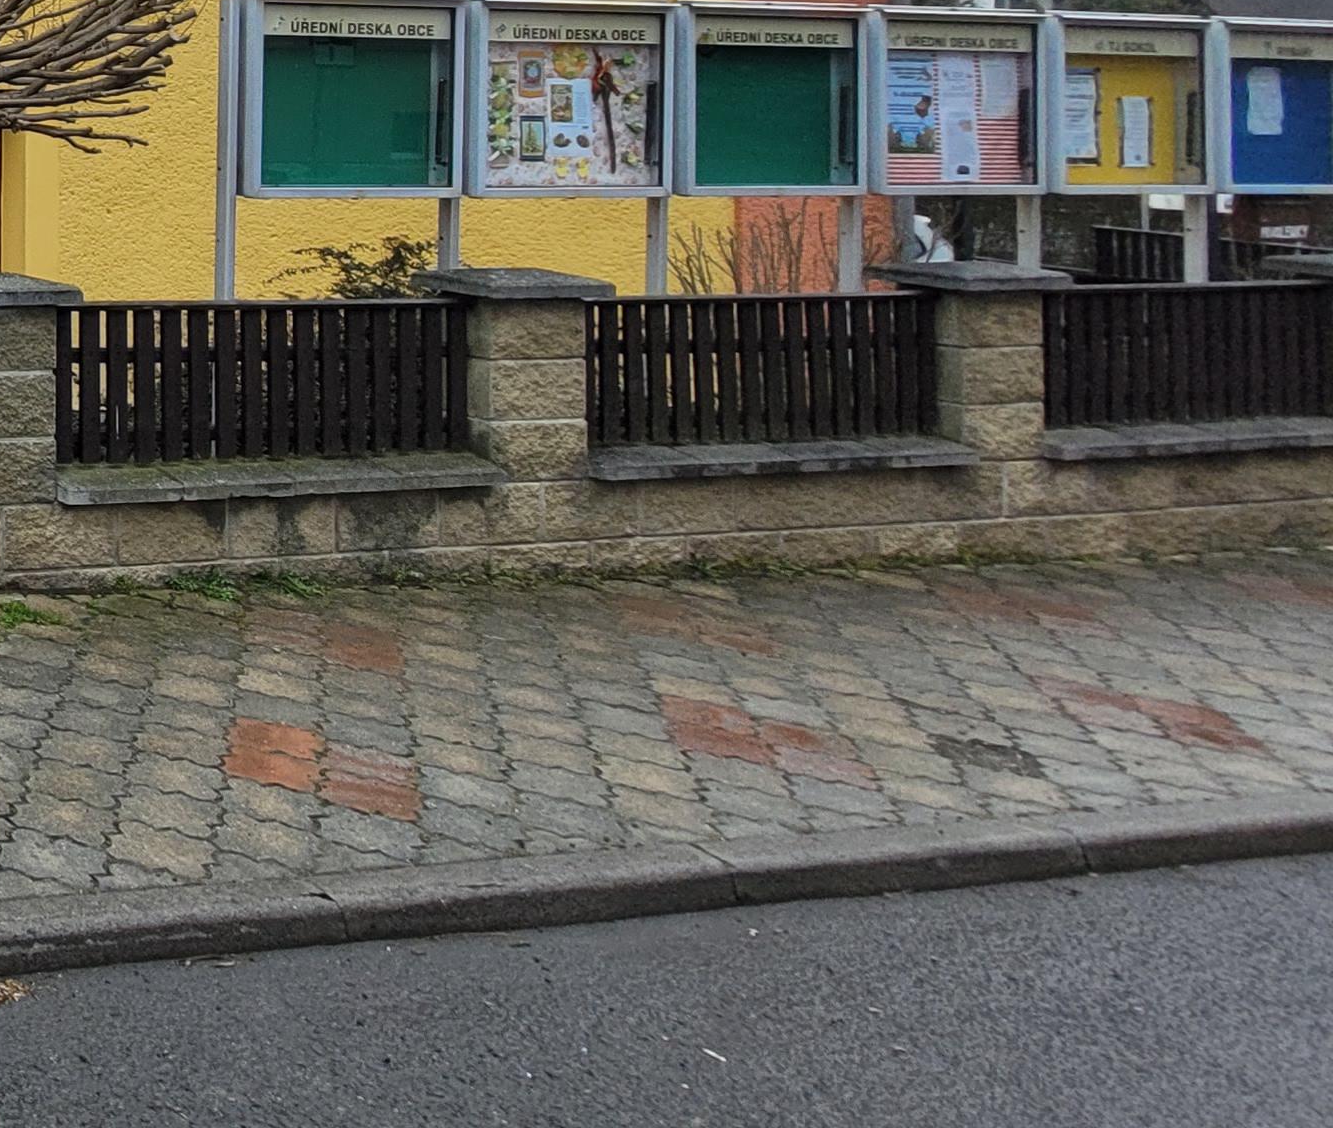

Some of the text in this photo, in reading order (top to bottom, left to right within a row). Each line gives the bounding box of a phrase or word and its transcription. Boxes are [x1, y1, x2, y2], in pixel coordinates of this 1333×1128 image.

[290, 16, 436, 37] ÚŘEDNÍ DESKA OBCE
[513, 24, 647, 41] ÚŘEDNÍ DESKA OBCE
[716, 27, 839, 45] ÚŘEDNÍ DESKA OBCE
